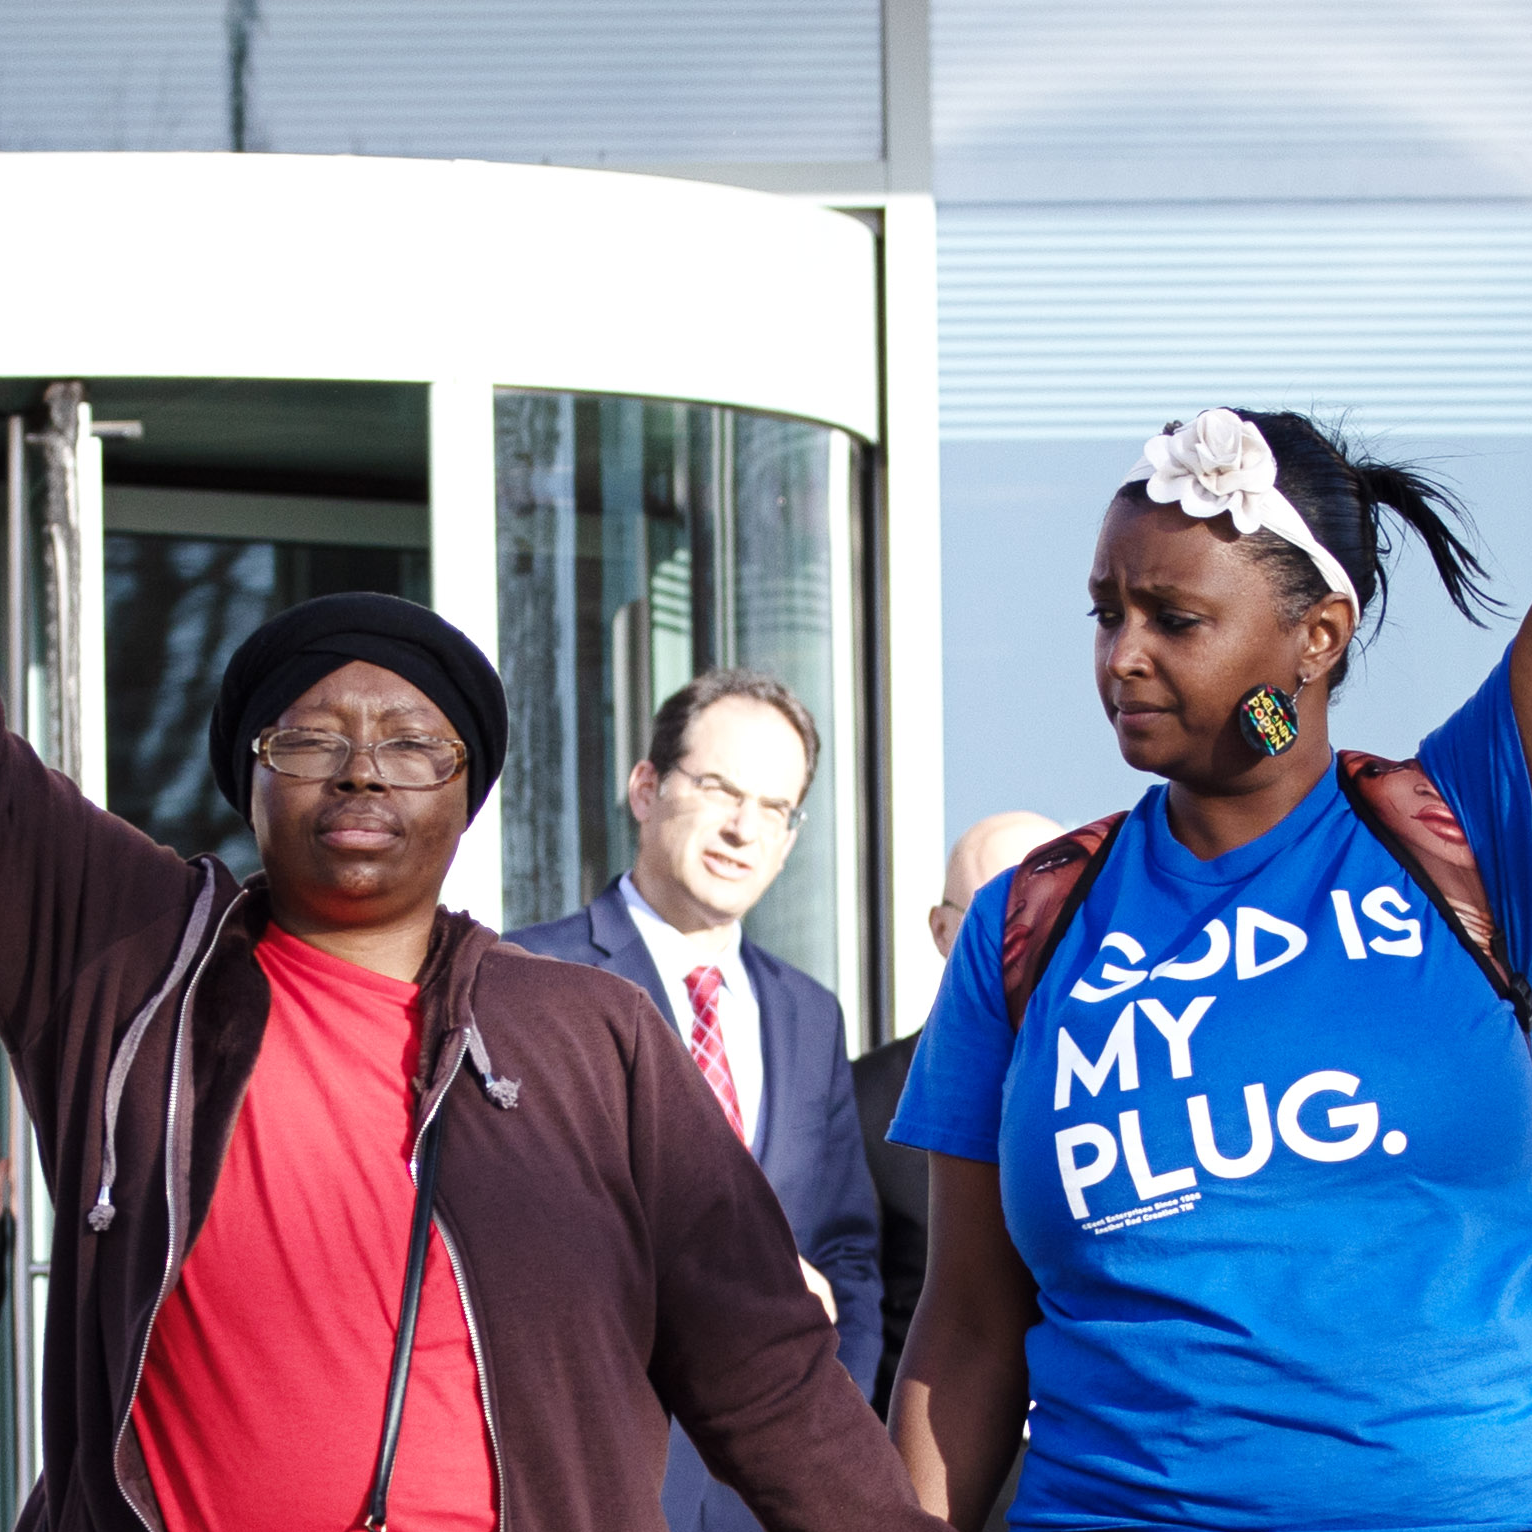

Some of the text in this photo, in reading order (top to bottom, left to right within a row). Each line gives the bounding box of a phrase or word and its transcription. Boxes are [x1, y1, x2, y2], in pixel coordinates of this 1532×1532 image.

[1257, 689, 1294, 743] MELANIN
[1069, 886, 1424, 1004] GOD IS
[1053, 995, 1218, 1112] MY
[1053, 1070, 1408, 1221] PLUG.
